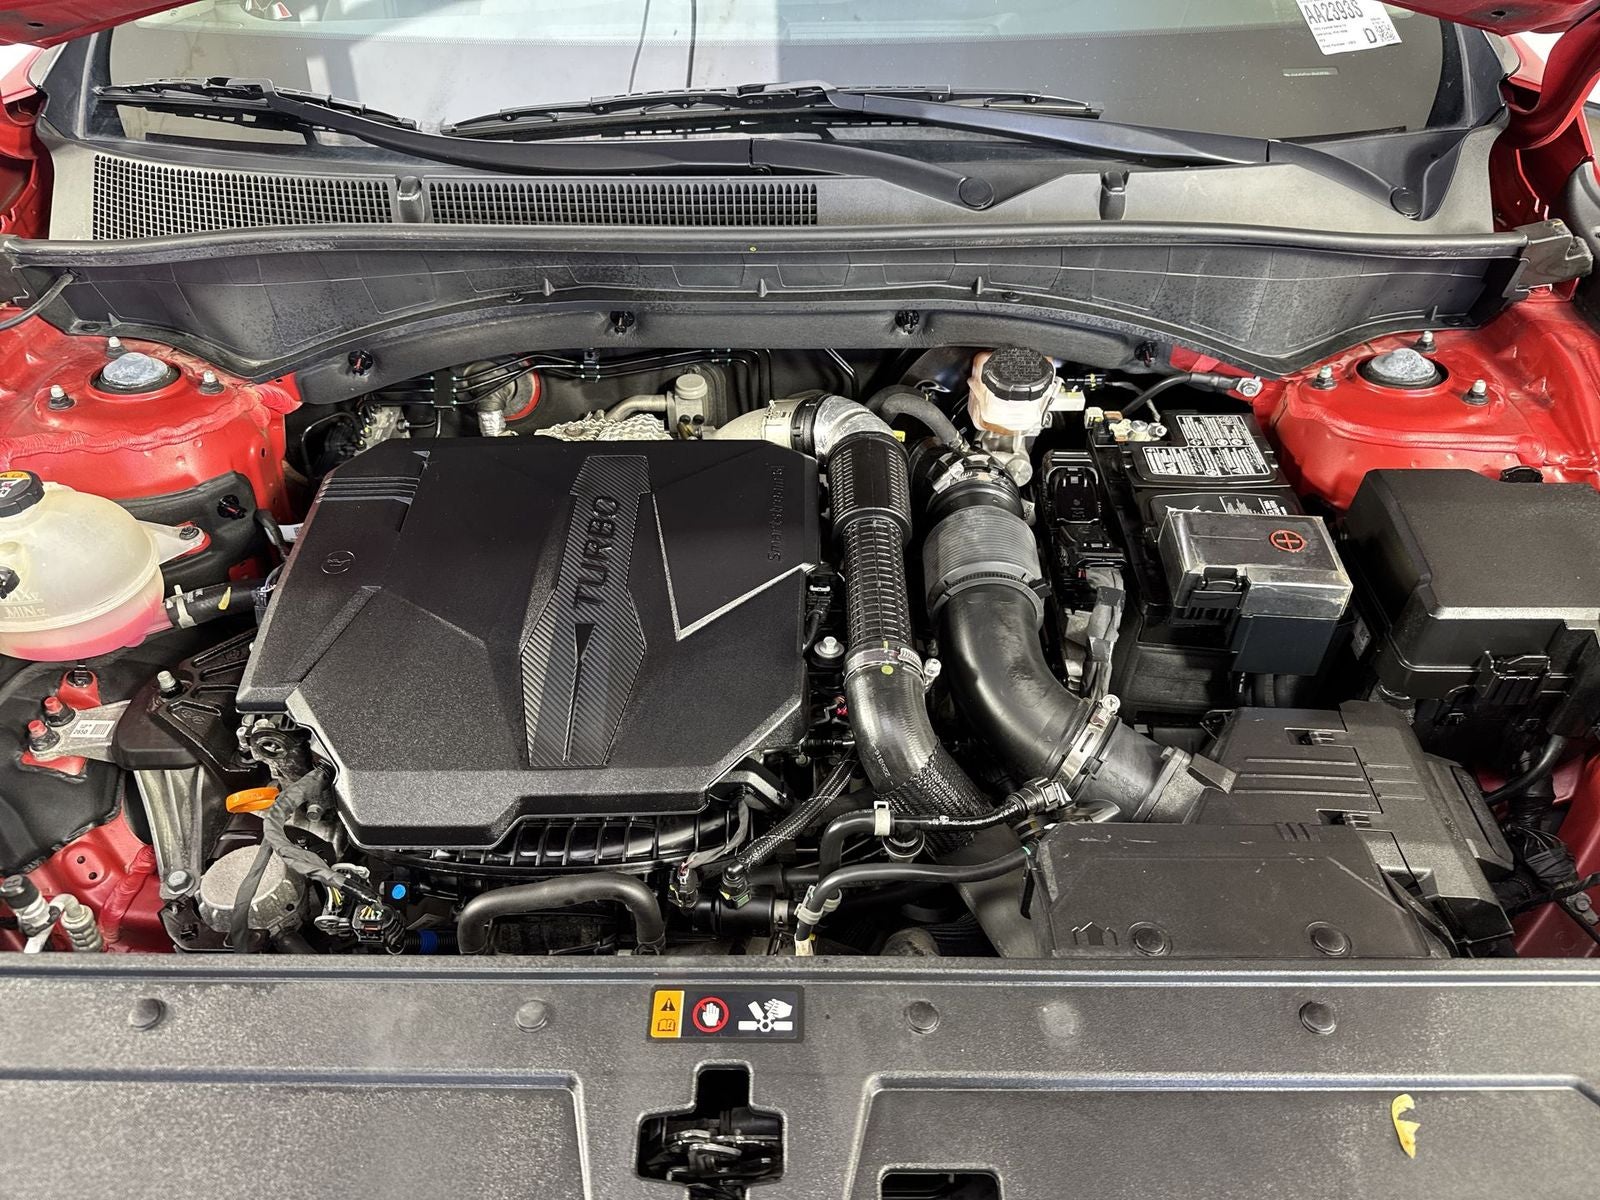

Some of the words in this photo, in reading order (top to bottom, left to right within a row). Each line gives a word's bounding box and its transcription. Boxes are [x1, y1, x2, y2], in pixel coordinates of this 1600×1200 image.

[1304, 0, 1363, 24] AA2393S
[572, 496, 618, 611] TURBO
[4, 605, 37, 618] MIN
